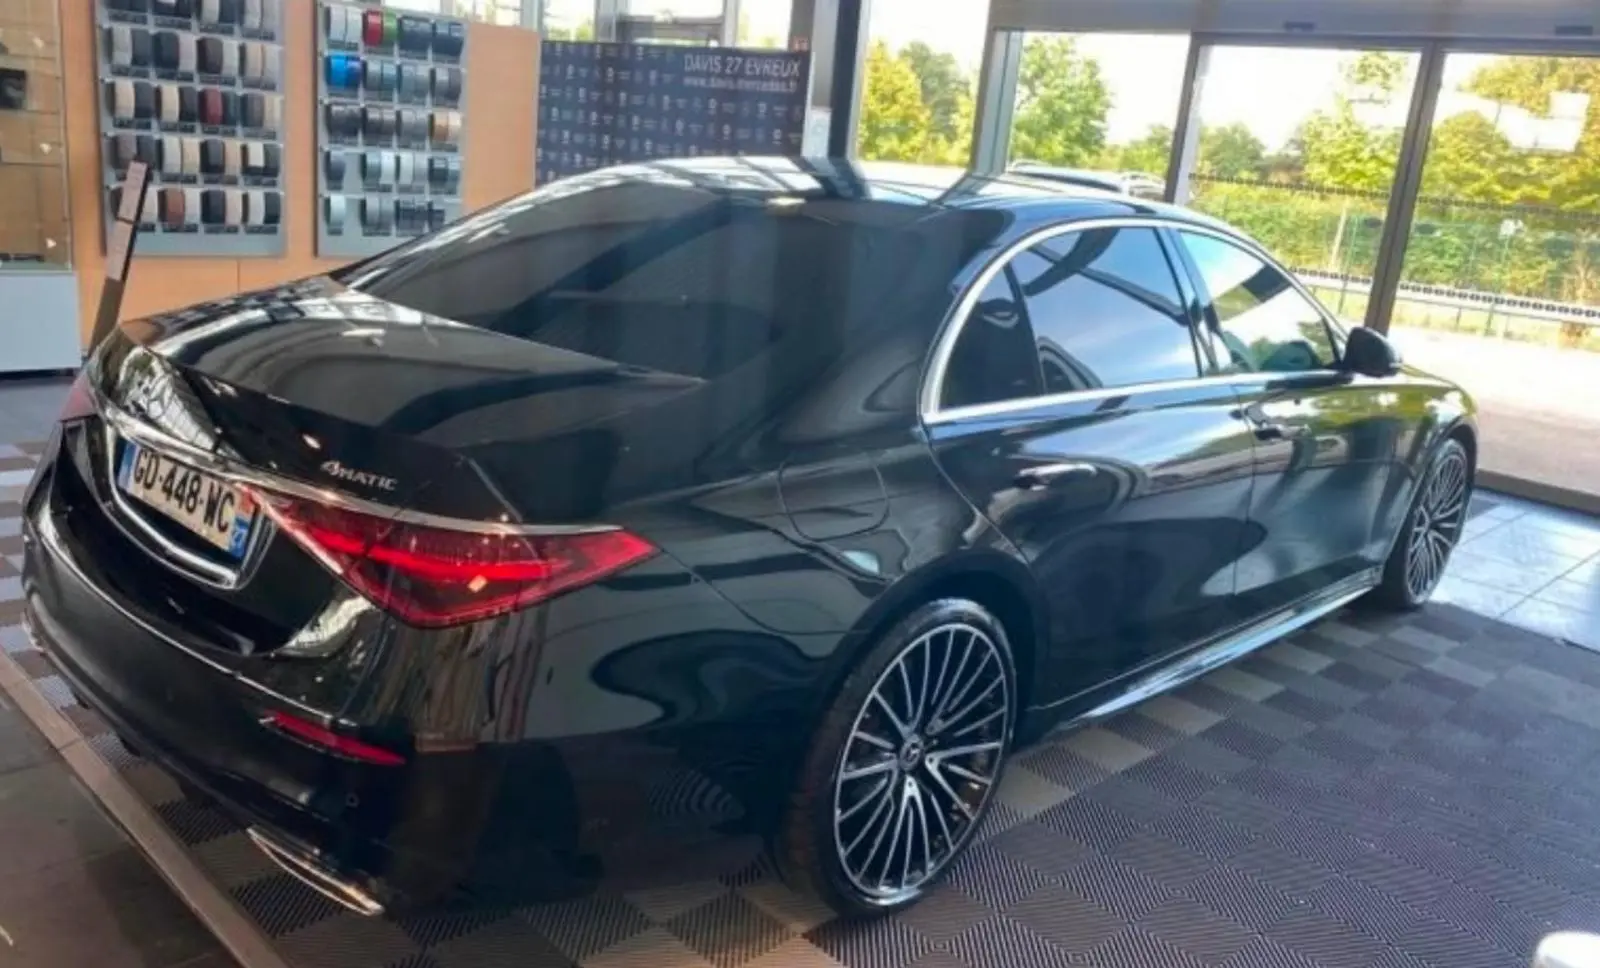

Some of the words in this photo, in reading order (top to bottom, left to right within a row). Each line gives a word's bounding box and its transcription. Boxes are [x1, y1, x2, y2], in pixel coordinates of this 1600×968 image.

[684, 53, 721, 73] DAVIS
[725, 56, 743, 75] 27
[744, 57, 801, 78] EVREUX
[134, 447, 235, 533] GD-448-WC
[320, 460, 397, 491] 4MATIC
